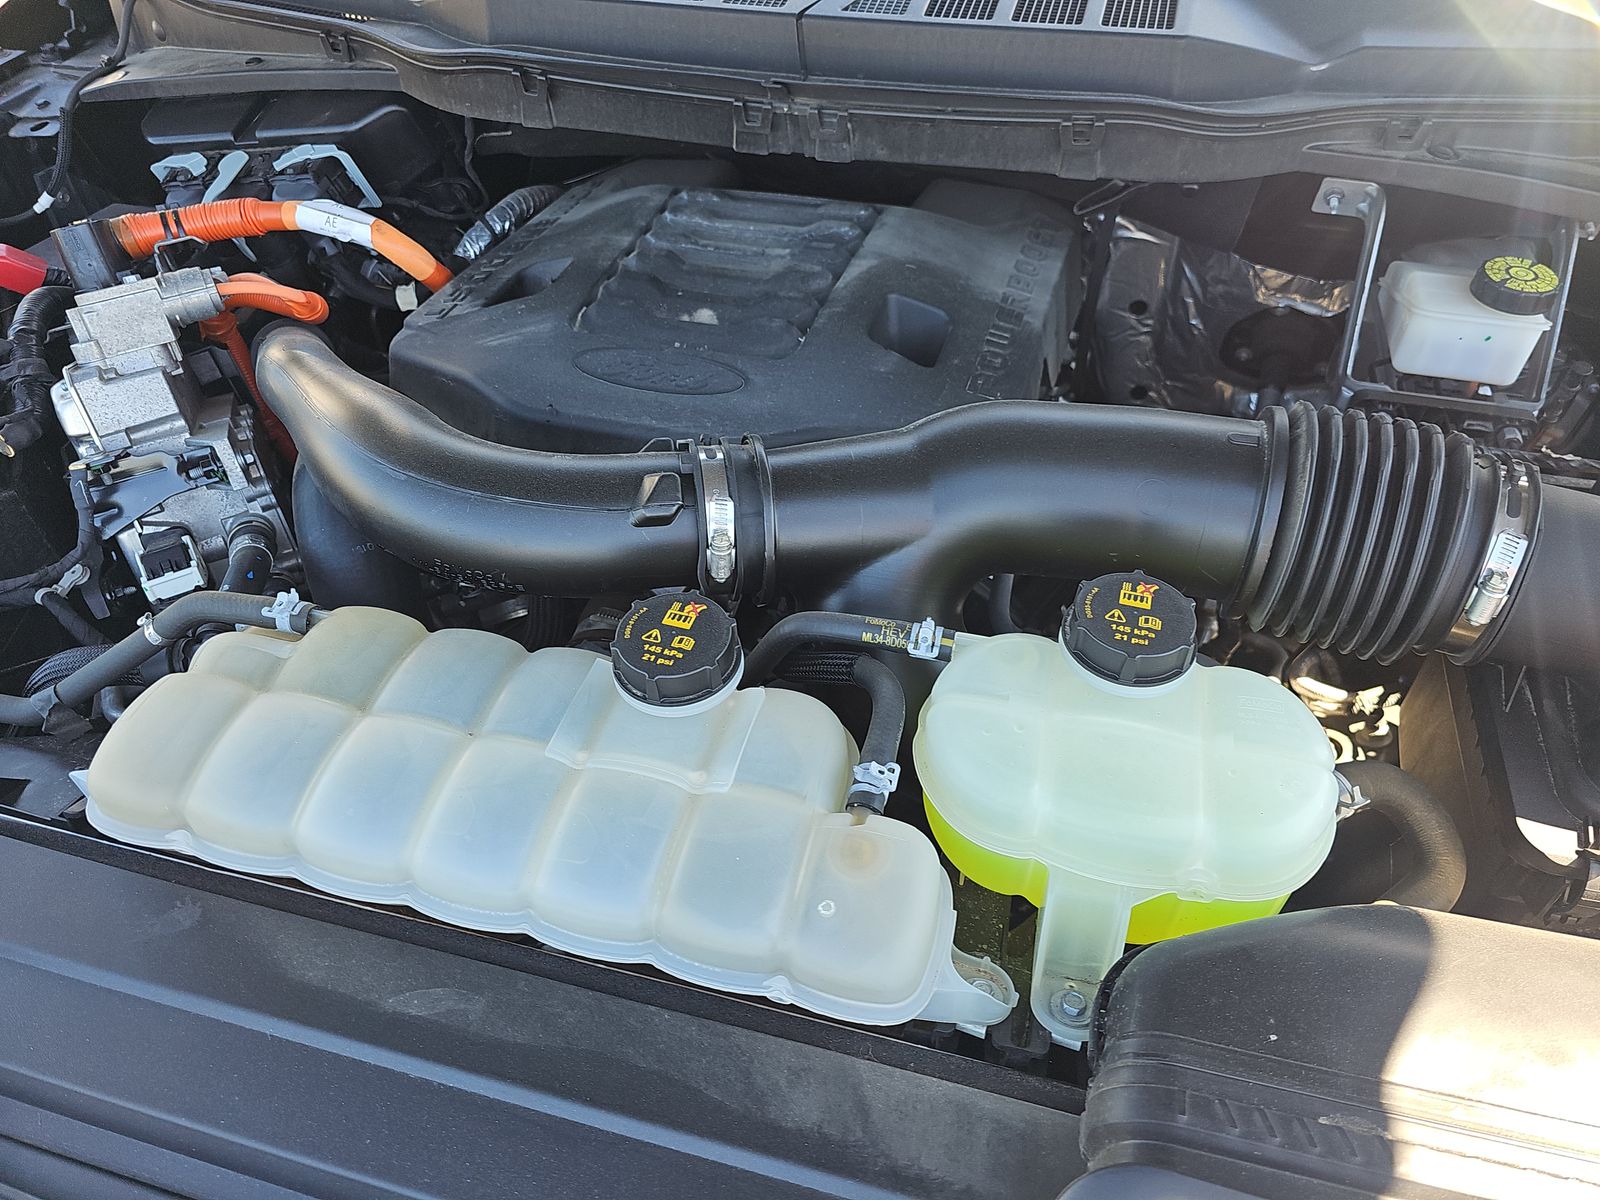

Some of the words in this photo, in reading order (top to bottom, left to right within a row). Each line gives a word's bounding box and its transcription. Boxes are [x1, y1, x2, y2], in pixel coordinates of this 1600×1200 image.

[324, 215, 338, 229] AE
[965, 219, 1056, 401] POWERBOOS
[881, 625, 907, 639] HEV
[1110, 623, 1131, 633] 145
[1133, 628, 1156, 638] kPa
[1113, 633, 1128, 641] 21
[1131, 637, 1149, 646] psi
[643, 644, 662, 653] 145
[663, 648, 684, 659] kPa
[641, 653, 656, 662] 21
[656, 658, 674, 666] psi
